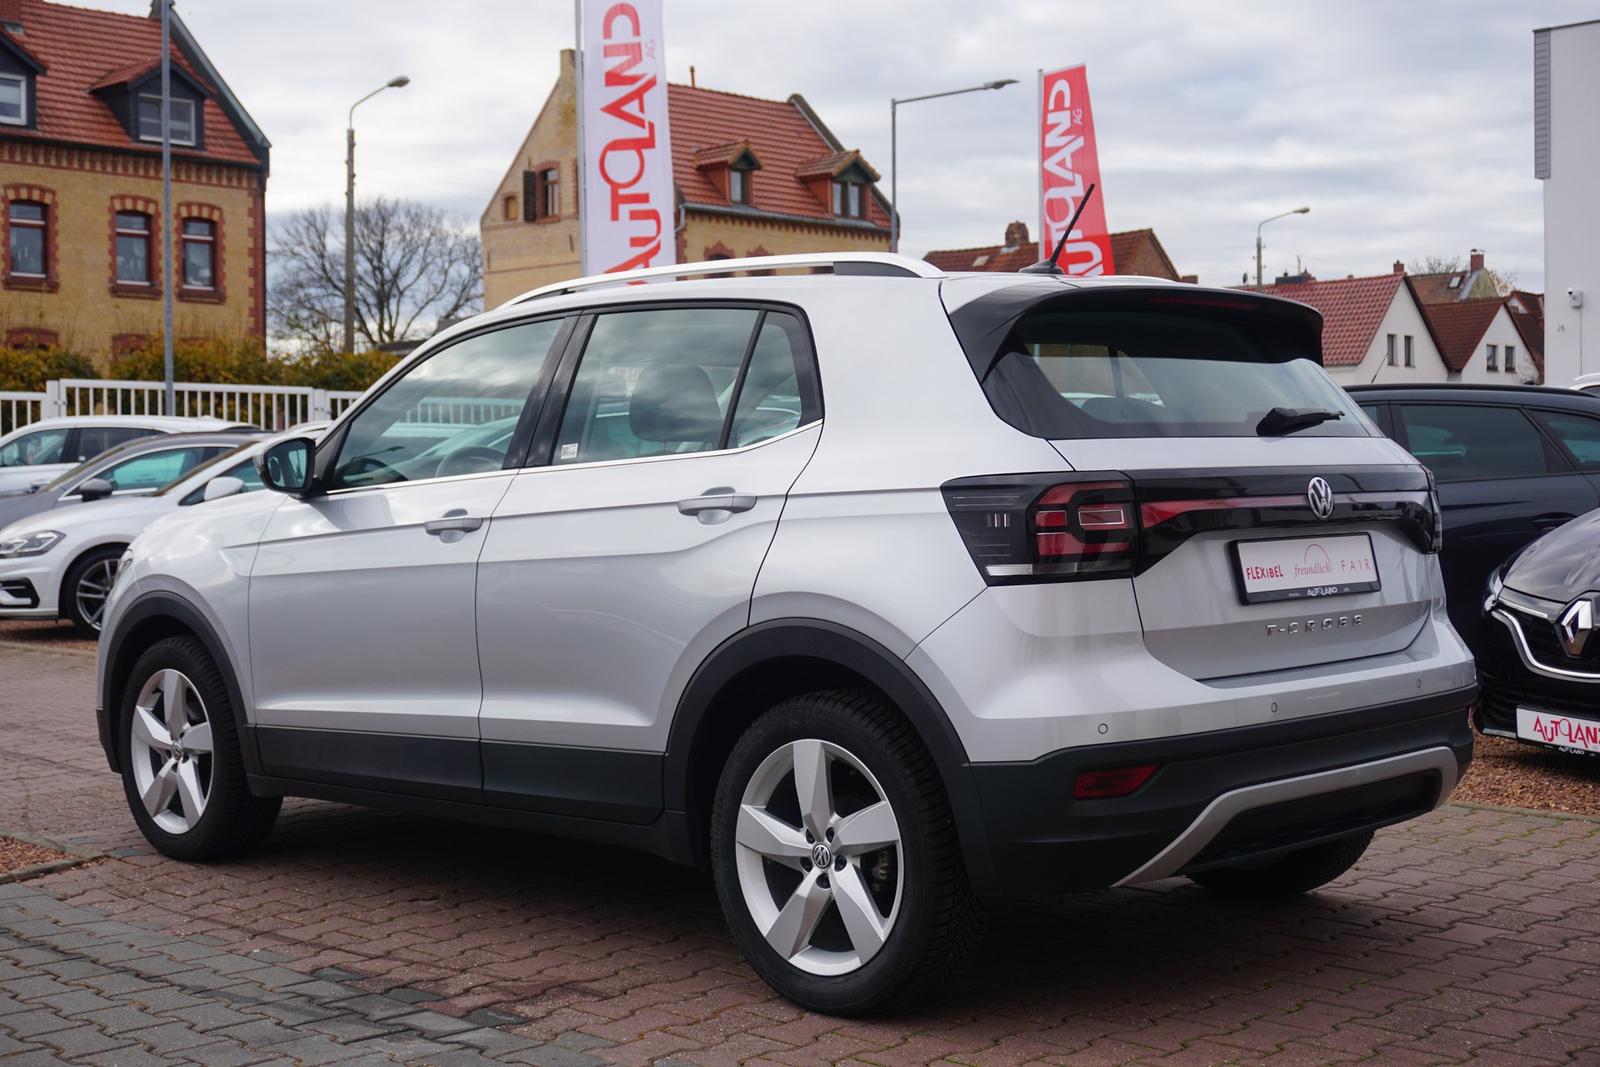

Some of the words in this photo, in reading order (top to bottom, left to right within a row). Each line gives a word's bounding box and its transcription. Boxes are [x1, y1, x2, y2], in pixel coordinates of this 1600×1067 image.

[1073, 108, 1083, 125] AG
[1043, 79, 1105, 276] UTOLAND
[1294, 561, 1333, 580] freundlich
[1265, 615, 1362, 636] T-CROSS
[1534, 715, 1600, 748] AUTOLAN
